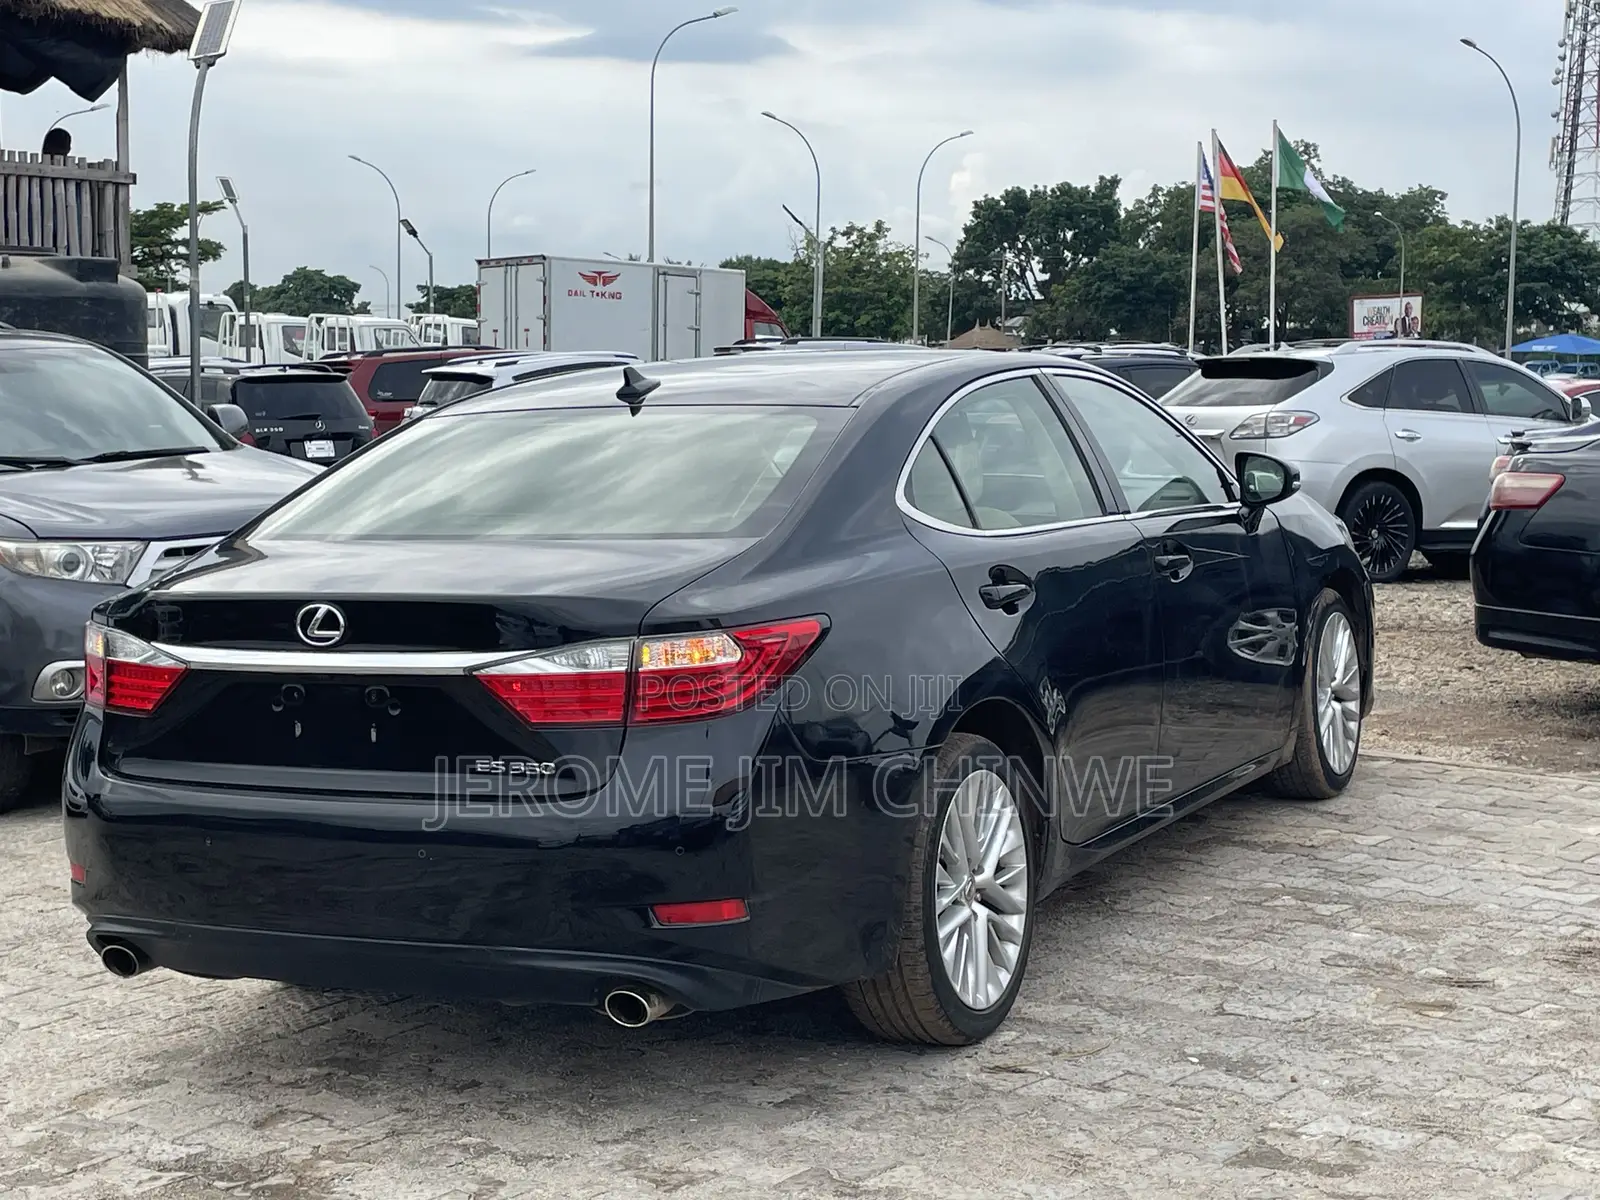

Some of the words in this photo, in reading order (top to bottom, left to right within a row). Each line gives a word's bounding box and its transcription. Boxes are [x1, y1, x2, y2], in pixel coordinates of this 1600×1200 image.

[1367, 306, 1391, 317] WEALTH
[1362, 315, 1393, 326] CREATION
[475, 759, 506, 774] ES
[509, 761, 557, 776] 350
